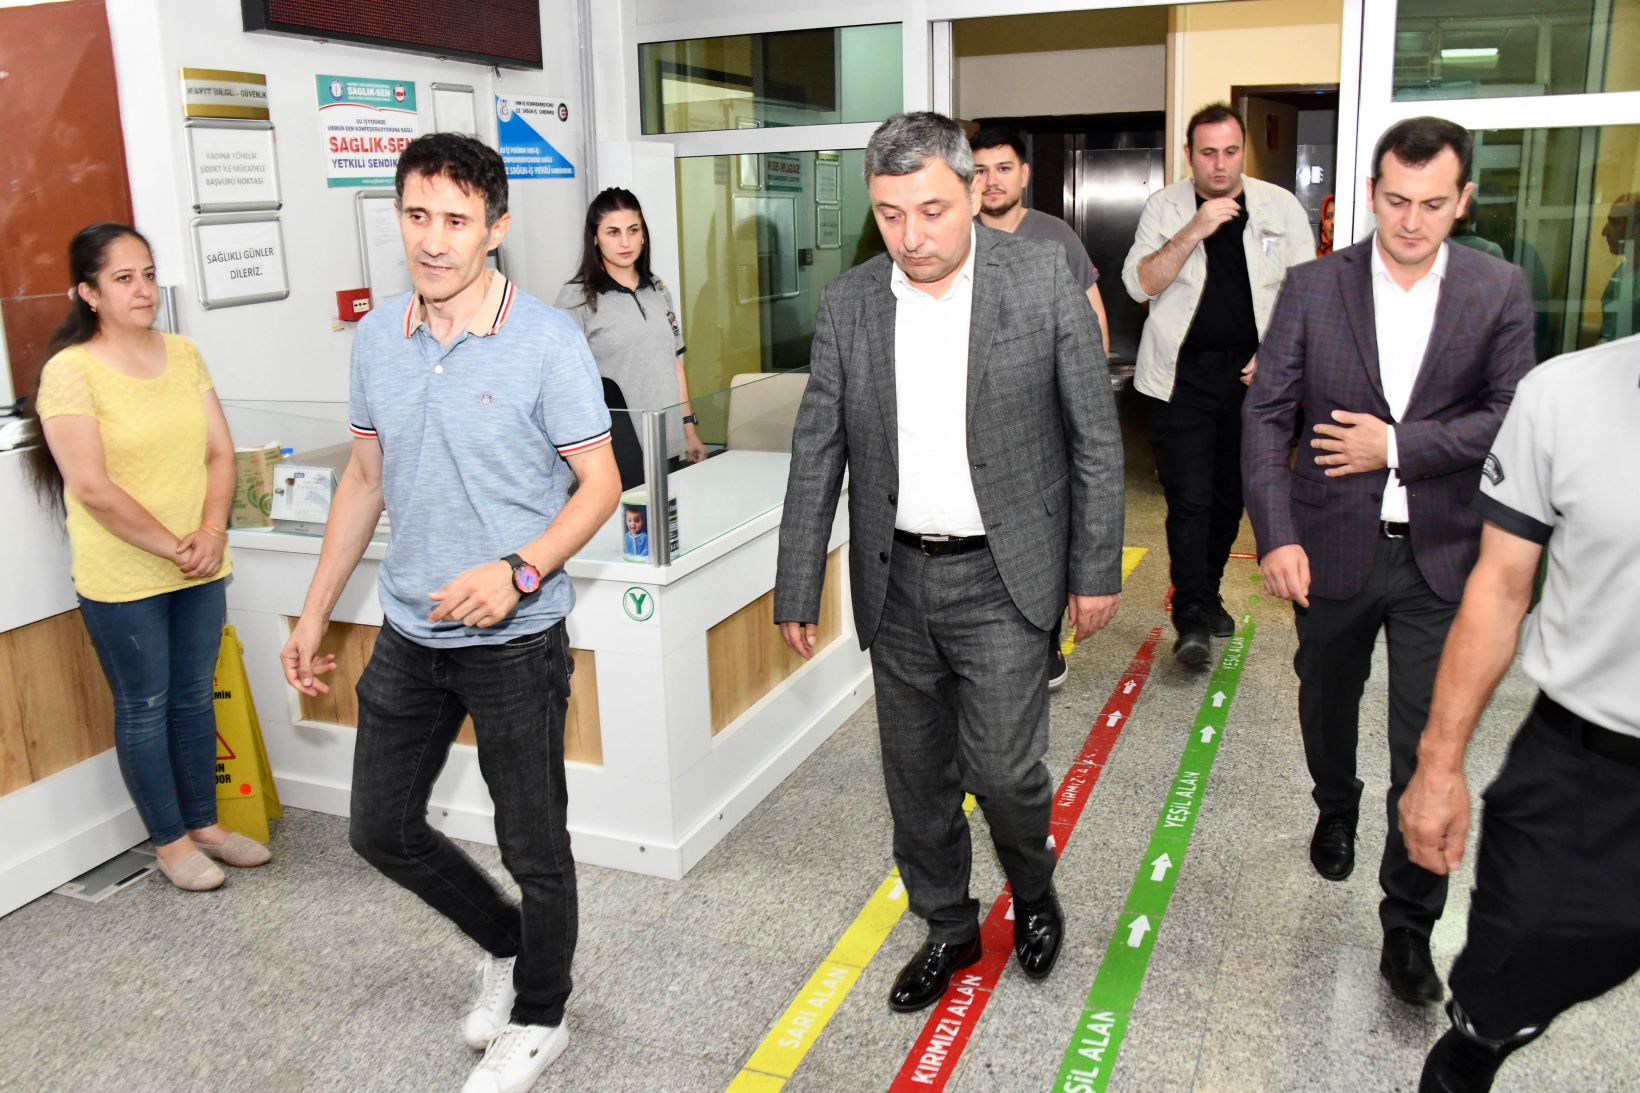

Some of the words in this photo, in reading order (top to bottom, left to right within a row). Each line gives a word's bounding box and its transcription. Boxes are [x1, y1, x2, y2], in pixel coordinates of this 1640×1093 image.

[206, 152, 230, 160] KADINA
[232, 151, 257, 160] YÖNELİK
[331, 156, 365, 168] YETKİLİ
[367, 157, 398, 168] SENDİK
[200, 164, 222, 174] ŞİDDET
[223, 163, 232, 172] İLE
[233, 163, 266, 172] MÜCADELE
[206, 178, 235, 187] BAŞVURU
[237, 178, 263, 186] NOKTASI
[206, 251, 242, 264] SAĞLIKLI
[243, 247, 274, 259] GÜNLER
[230, 266, 262, 280] DİLERİZ.
[629, 593, 647, 614] Y
[212, 690, 231, 699] MİN
[1163, 797, 1192, 828] YEŞİL
[1182, 771, 1201, 798] ALAN
[778, 1009, 818, 1049] SARI
[806, 967, 849, 1010] ALAN
[911, 1019, 962, 1084] KIRMIZI
[946, 974, 983, 1019] ALAN
[1078, 1010, 1115, 1061] ALAN
[1063, 1066, 1099, 1093] ŞİL
